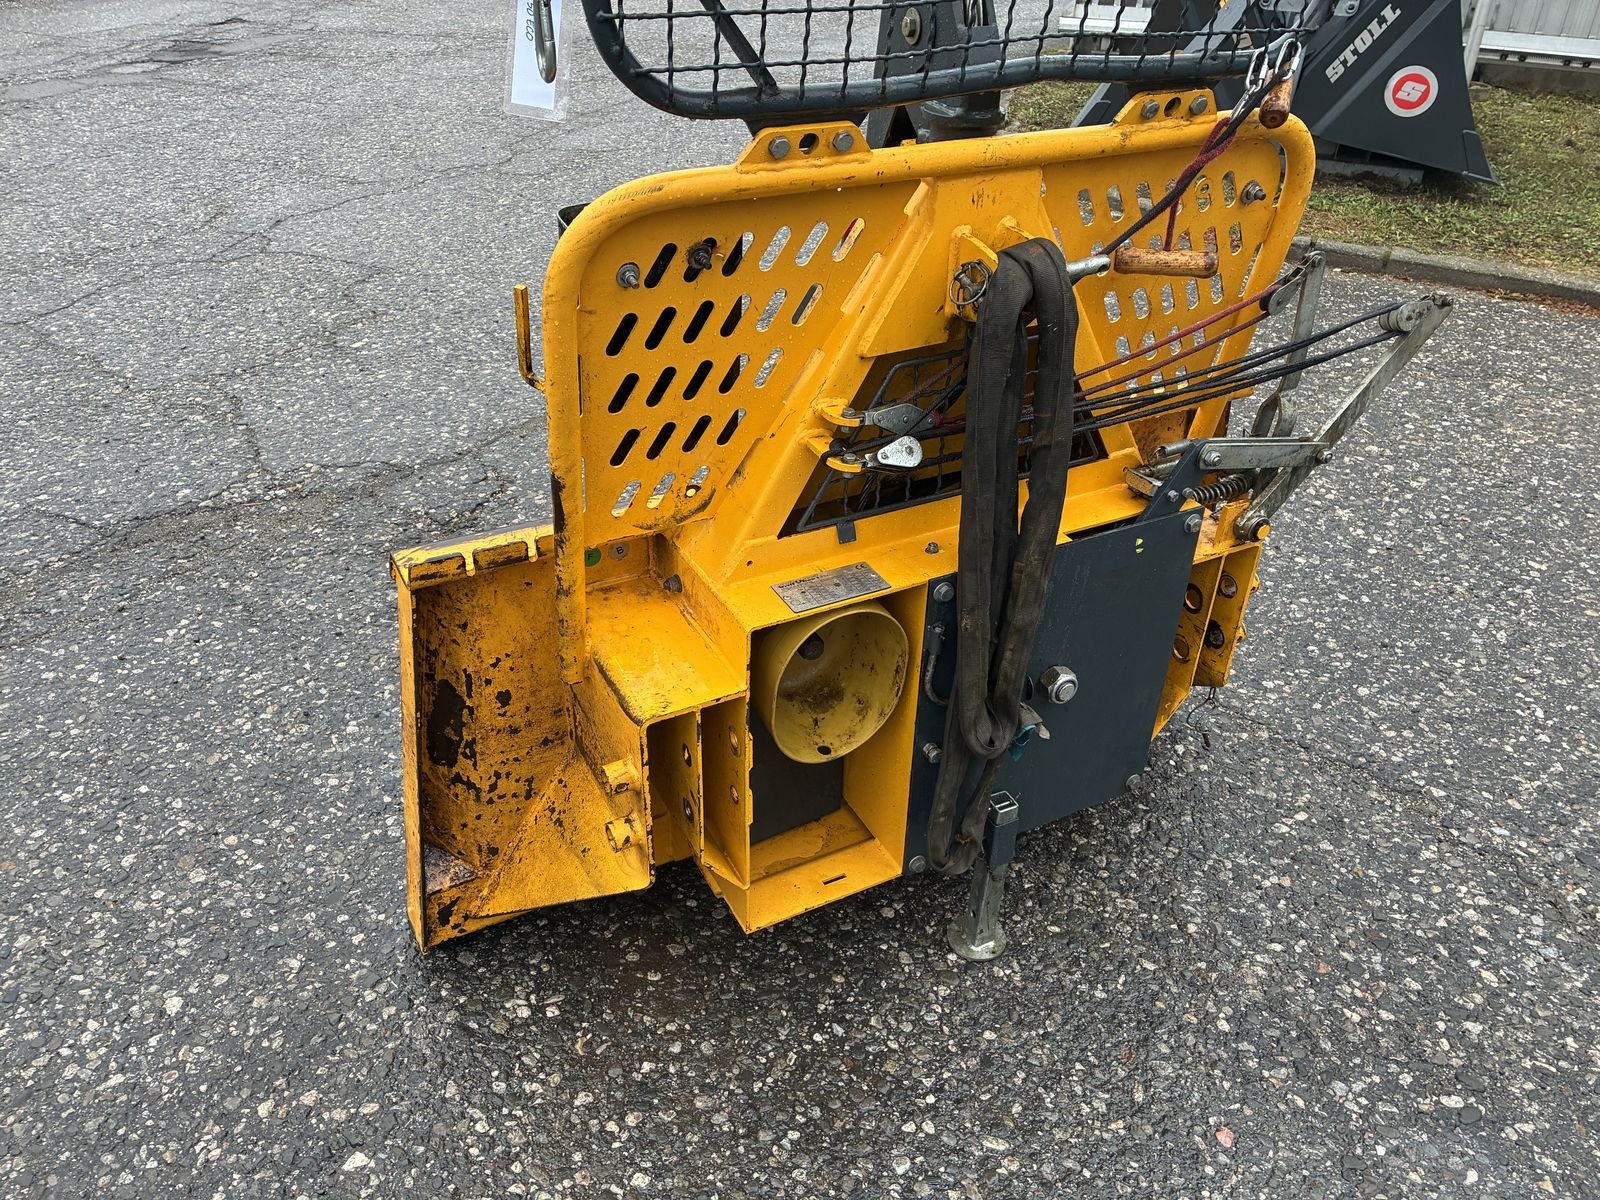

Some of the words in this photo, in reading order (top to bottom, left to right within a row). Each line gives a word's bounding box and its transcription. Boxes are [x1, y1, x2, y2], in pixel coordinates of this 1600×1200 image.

[1325, 4, 1402, 84] STOLL
[1395, 80, 1428, 103] S
[615, 546, 624, 555] B
